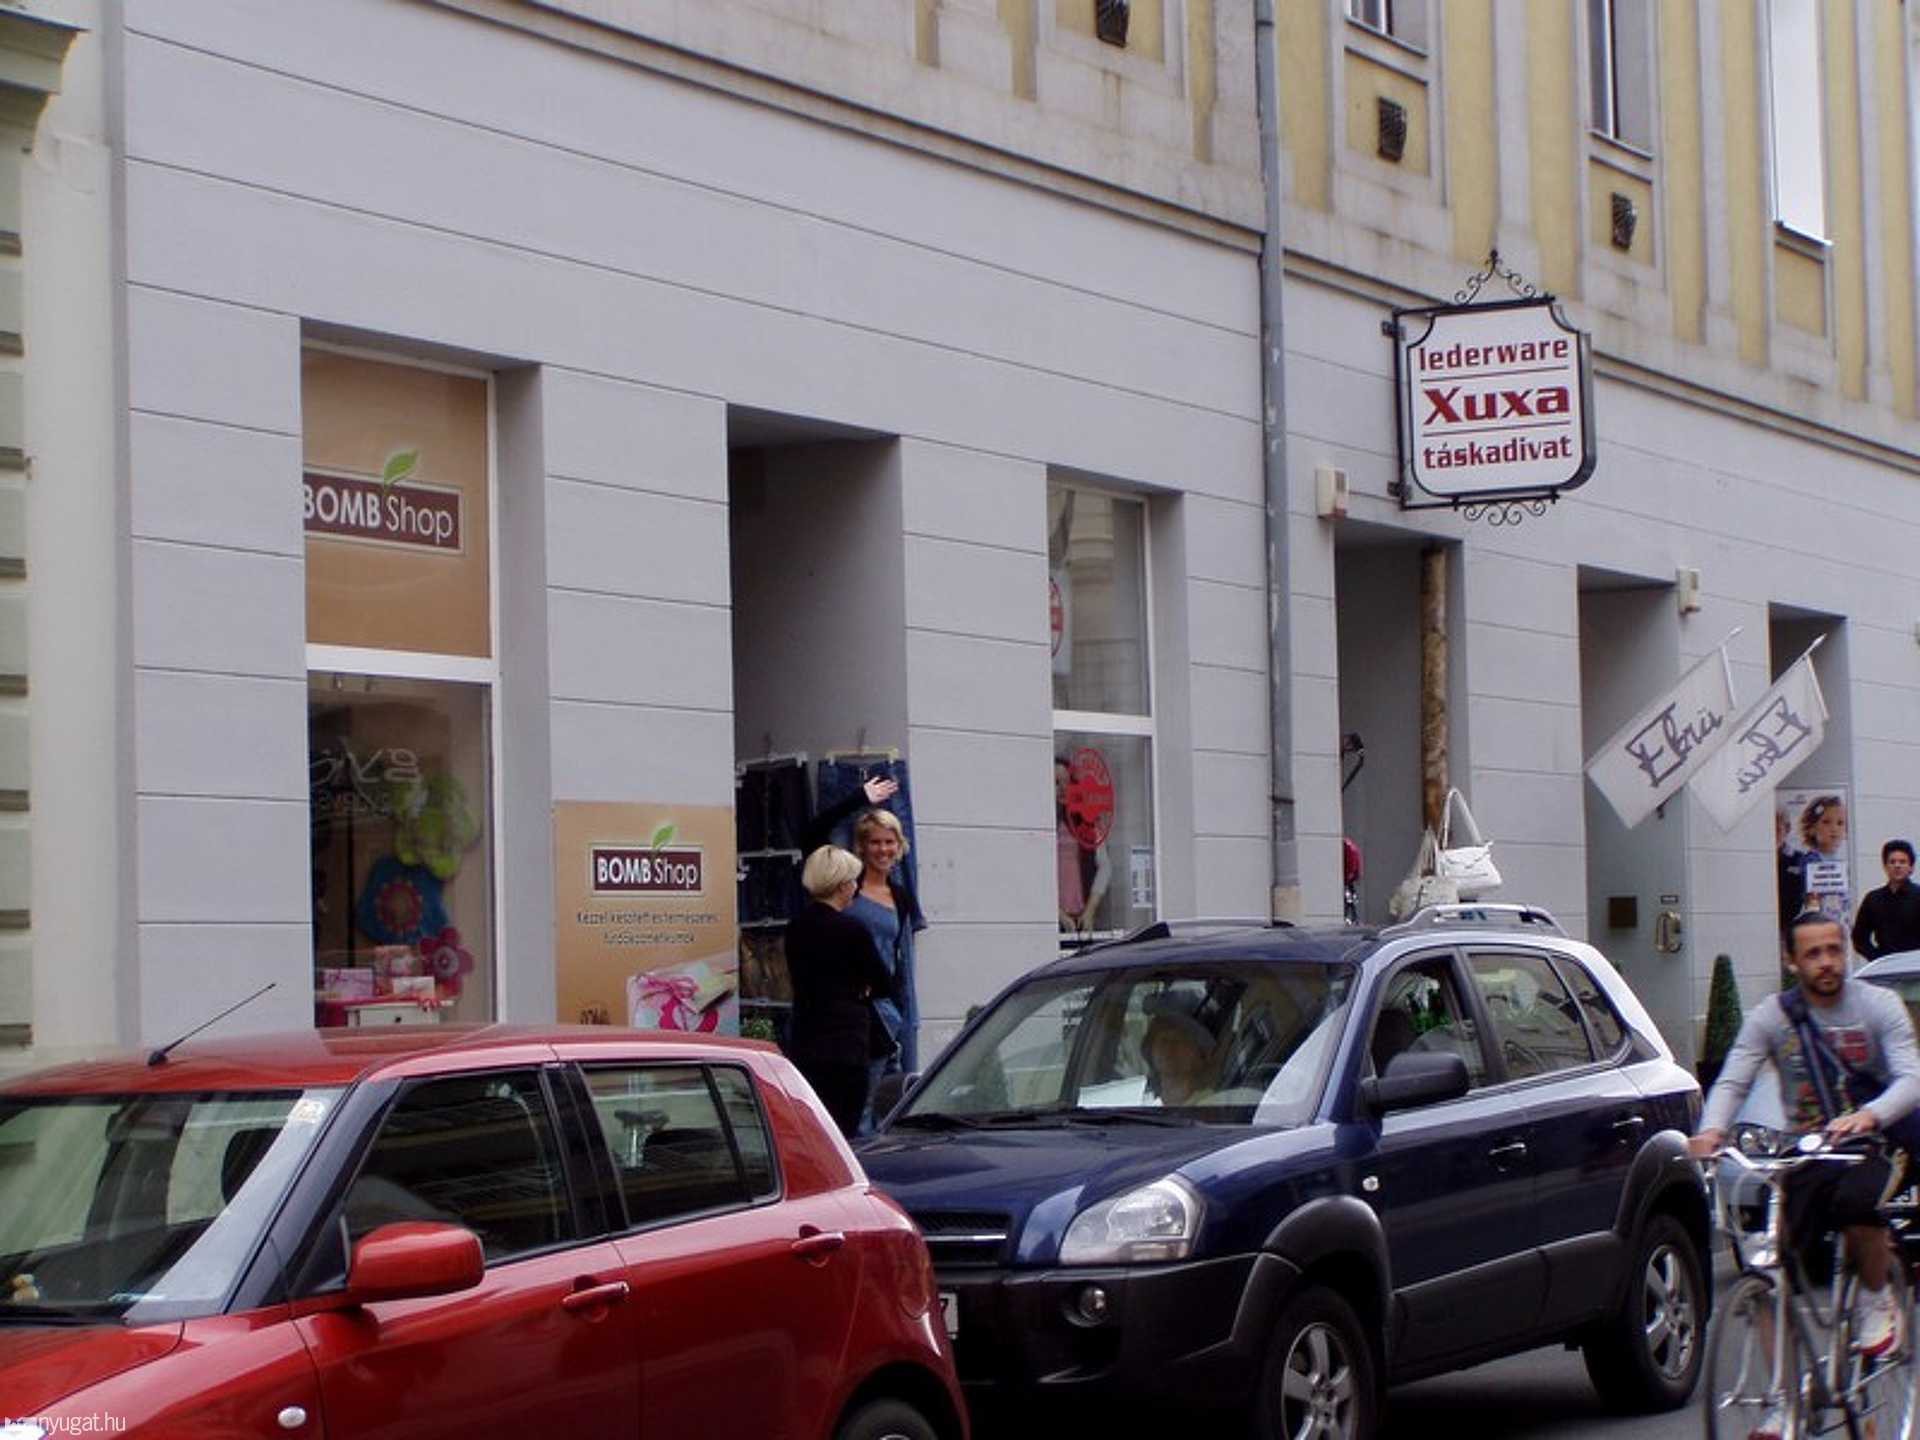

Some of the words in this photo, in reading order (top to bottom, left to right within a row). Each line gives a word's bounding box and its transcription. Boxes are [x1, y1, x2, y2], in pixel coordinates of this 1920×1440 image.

[1419, 338, 1569, 371] lederware
[1423, 386, 1571, 425] Xuxa
[1423, 435, 1573, 469] táskadivat
[303, 484, 381, 528] BOMB
[386, 495, 453, 545] Shop
[597, 856, 651, 884] BOMB
[654, 857, 698, 888] Shop
